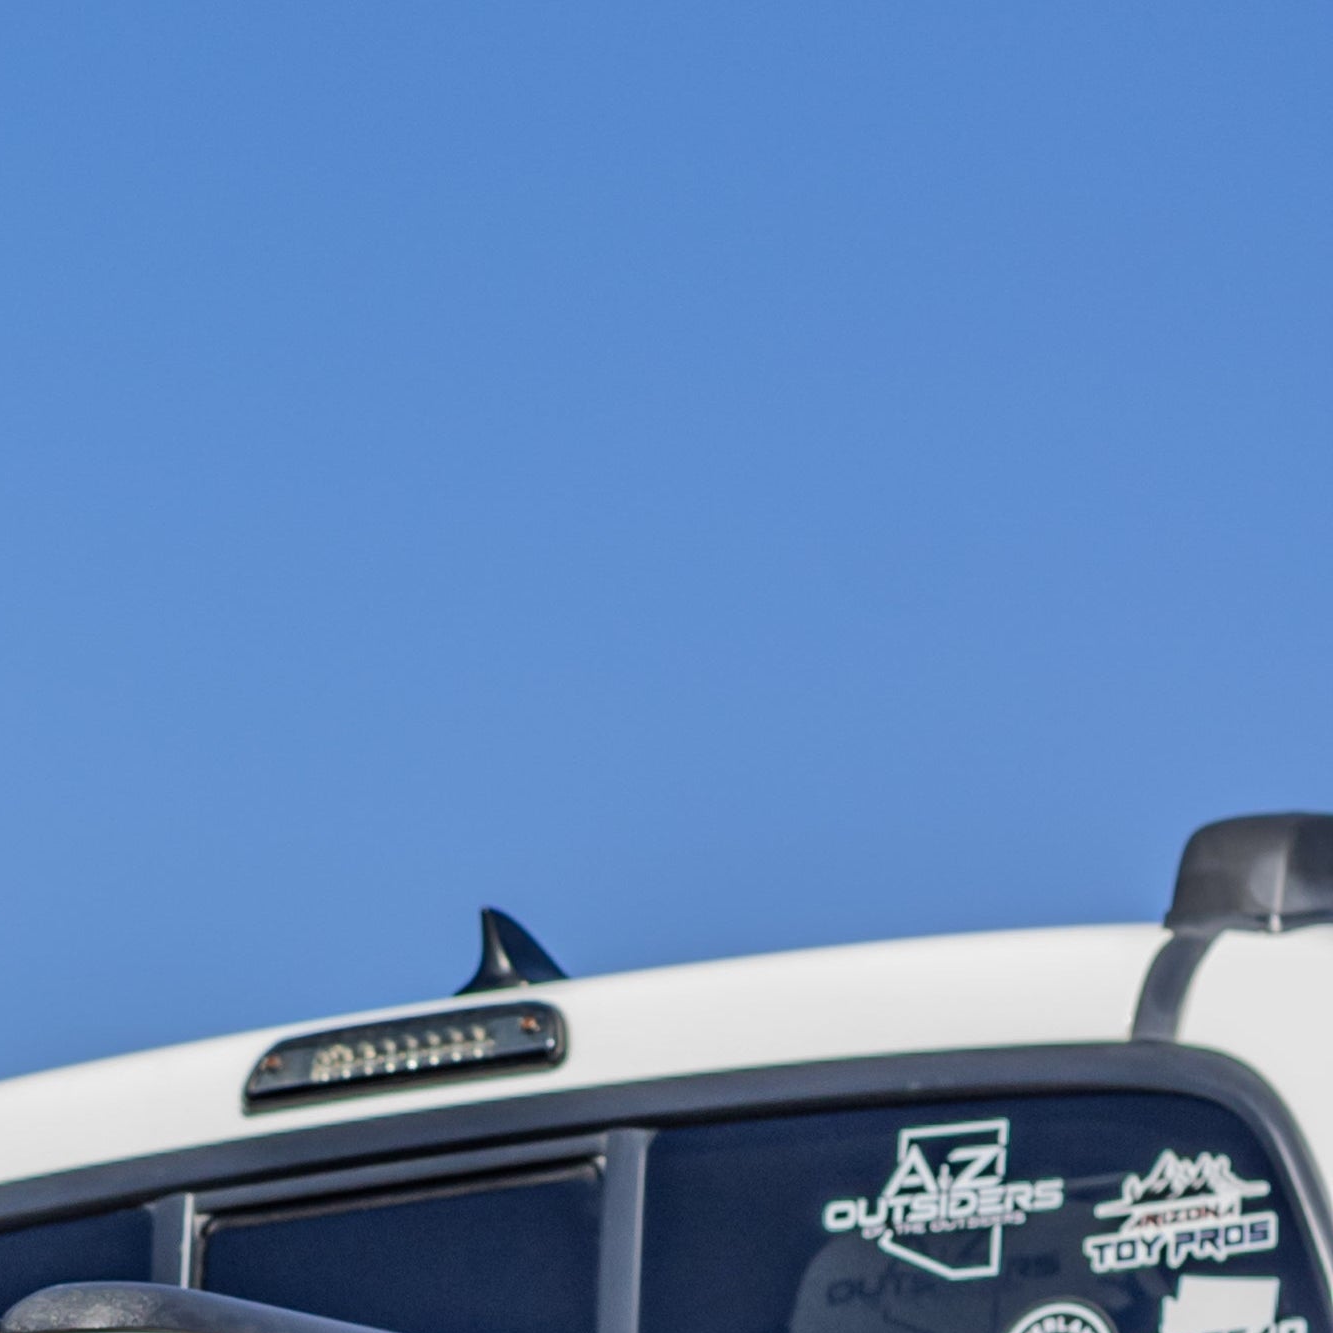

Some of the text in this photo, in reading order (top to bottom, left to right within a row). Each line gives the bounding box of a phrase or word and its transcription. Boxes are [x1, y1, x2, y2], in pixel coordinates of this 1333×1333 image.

[822, 1176, 1065, 1232] OUTSIDERS
[1088, 1218, 1274, 1267] TOY PROS
